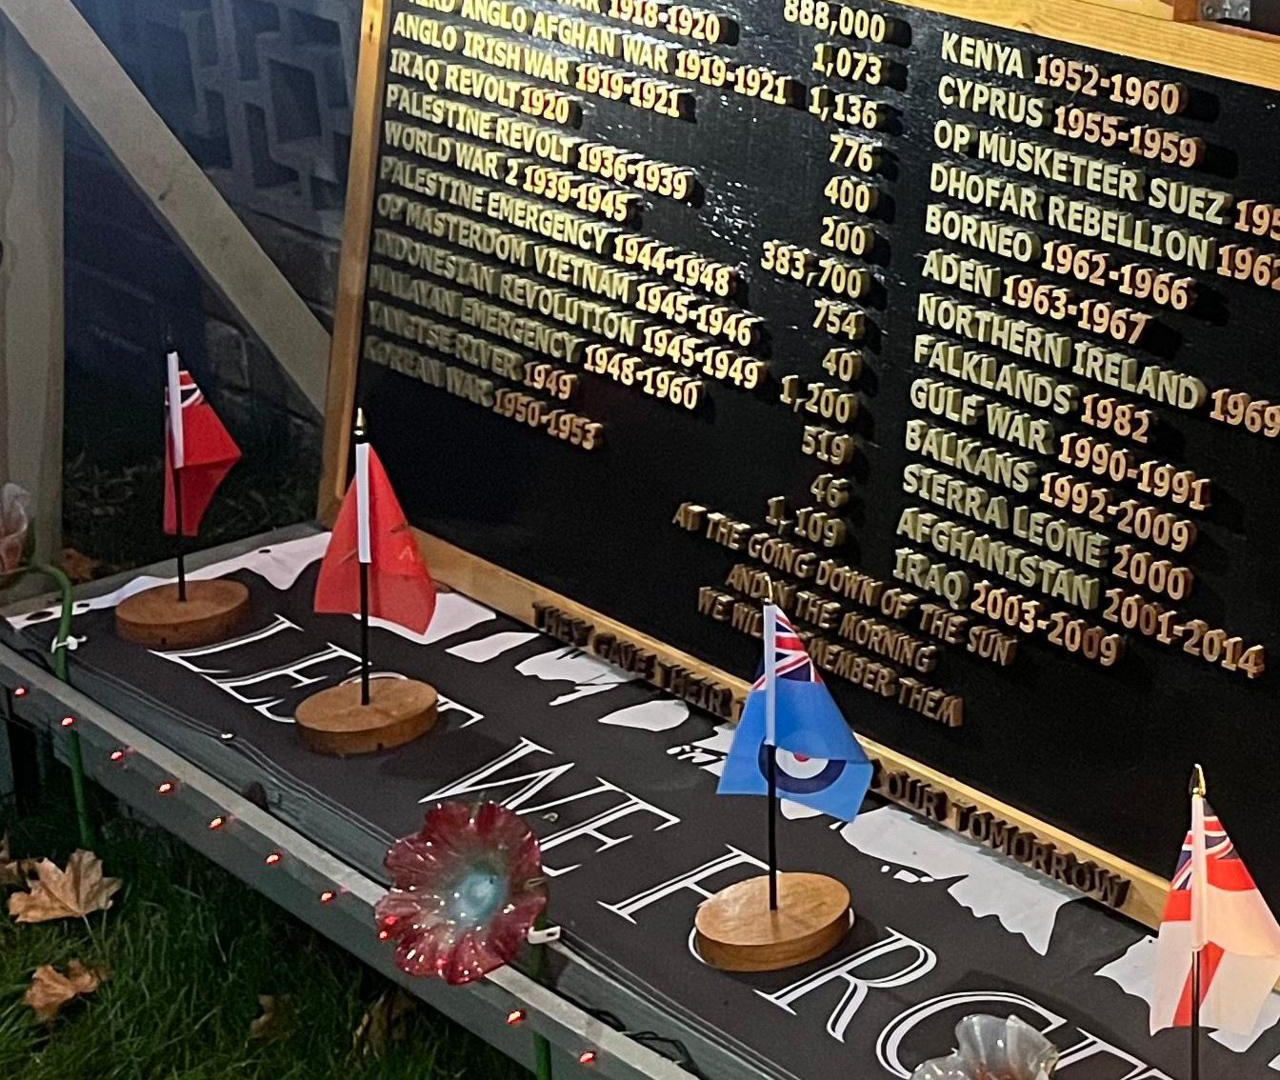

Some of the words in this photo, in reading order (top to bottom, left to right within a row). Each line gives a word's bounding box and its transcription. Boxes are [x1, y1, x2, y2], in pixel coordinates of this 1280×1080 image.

[389, 48, 439, 90] IRAQ
[444, 63, 519, 108] REVOLT
[519, 82, 571, 125] 1920
[392, 13, 458, 52] ANGLO
[463, 29, 523, 71] IRISH
[524, 44, 569, 86] WAR
[575, 63, 684, 118] 1919-1921
[531, 9, 616, 58] AFGHAN
[622, 33, 669, 75] WAR
[676, 49, 789, 106] 1919-1921
[807, 86, 878, 130] 1,136
[811, 43, 882, 86] 1,073
[940, 31, 1025, 80] KENYA
[1033, 55, 1188, 116] 1952-1960
[383, 121, 449, 166] WORLD
[455, 140, 499, 180] WAR
[504, 164, 519, 185] 2
[522, 165, 630, 223] 1939-1945
[386, 84, 494, 141] PALESTINE
[495, 113, 574, 166] REVOLT
[576, 143, 689, 201] 1936-1939
[829, 135, 874, 174] 776
[933, 119, 975, 154] OP
[977, 131, 1144, 203] MUSKETEER
[1148, 178, 1233, 227] SUEZ
[937, 74, 1048, 129] CYPRUS
[1052, 104, 1205, 170] 1955-1959
[379, 161, 484, 210] PALESTINE
[487, 190, 611, 254] EMERGENCY
[611, 234, 738, 298] 1944-1948
[820, 217, 873, 256] 200
[823, 177, 875, 214] 400
[929, 162, 1043, 221] DHOFAR
[1048, 195, 1216, 270] REBELLION
[377, 192, 402, 221] OP
[403, 204, 528, 267] MASTERDOM
[532, 243, 629, 304] VIETNAM
[634, 282, 754, 347] 1945-1946
[760, 241, 866, 299] 383,700
[921, 248, 1001, 298] ADEN
[1001, 275, 1153, 346] 1963-1967
[925, 203, 1038, 264] BORNEO
[1040, 240, 1197, 312] 1962-1966
[368, 264, 458, 318] MALAYAN
[460, 296, 580, 364] EMERGENCY
[584, 344, 703, 410] 1948-1960
[374, 228, 495, 291] INDONESIAN
[498, 268, 639, 347] REVOLUTION
[641, 326, 763, 390] 1945-1949
[812, 297, 864, 341] 754
[917, 292, 1071, 369] NORTHERN
[1072, 340, 1209, 412] IRELAND
[362, 333, 444, 391] KOREAN
[445, 363, 494, 408] WAR
[493, 387, 602, 451] 1950-1953
[454, 332, 521, 380] RIVER
[522, 361, 578, 401] 1949
[780, 374, 853, 424] 1,200
[821, 347, 860, 383] 40
[913, 334, 1080, 416] FALKLANDS
[1080, 393, 1152, 445] 1982
[801, 425, 852, 466] 519
[810, 472, 849, 509] 46
[905, 419, 1038, 494] BALKANS
[1039, 471, 1198, 555] 1992-2009
[909, 377, 985, 427] GULF
[986, 403, 1055, 456] WAR
[1058, 432, 1213, 512] 1990-1991
[765, 495, 846, 547] 1,109
[902, 464, 1010, 531] SIERRA
[1011, 505, 1110, 570] LEONE
[1112, 544, 1194, 602] 2000
[672, 502, 706, 531] AT
[706, 512, 750, 551] THE
[747, 529, 816, 579] GOING
[815, 559, 883, 607] DOWN
[880, 588, 921, 620] OF
[918, 603, 969, 644] THE
[966, 625, 1019, 667] SUN
[893, 548, 970, 612] IRAQ
[970, 580, 1126, 668] 2003-2009
[897, 507, 1101, 612] AFGHANISTAN
[1102, 588, 1267, 680] 2001-2014
